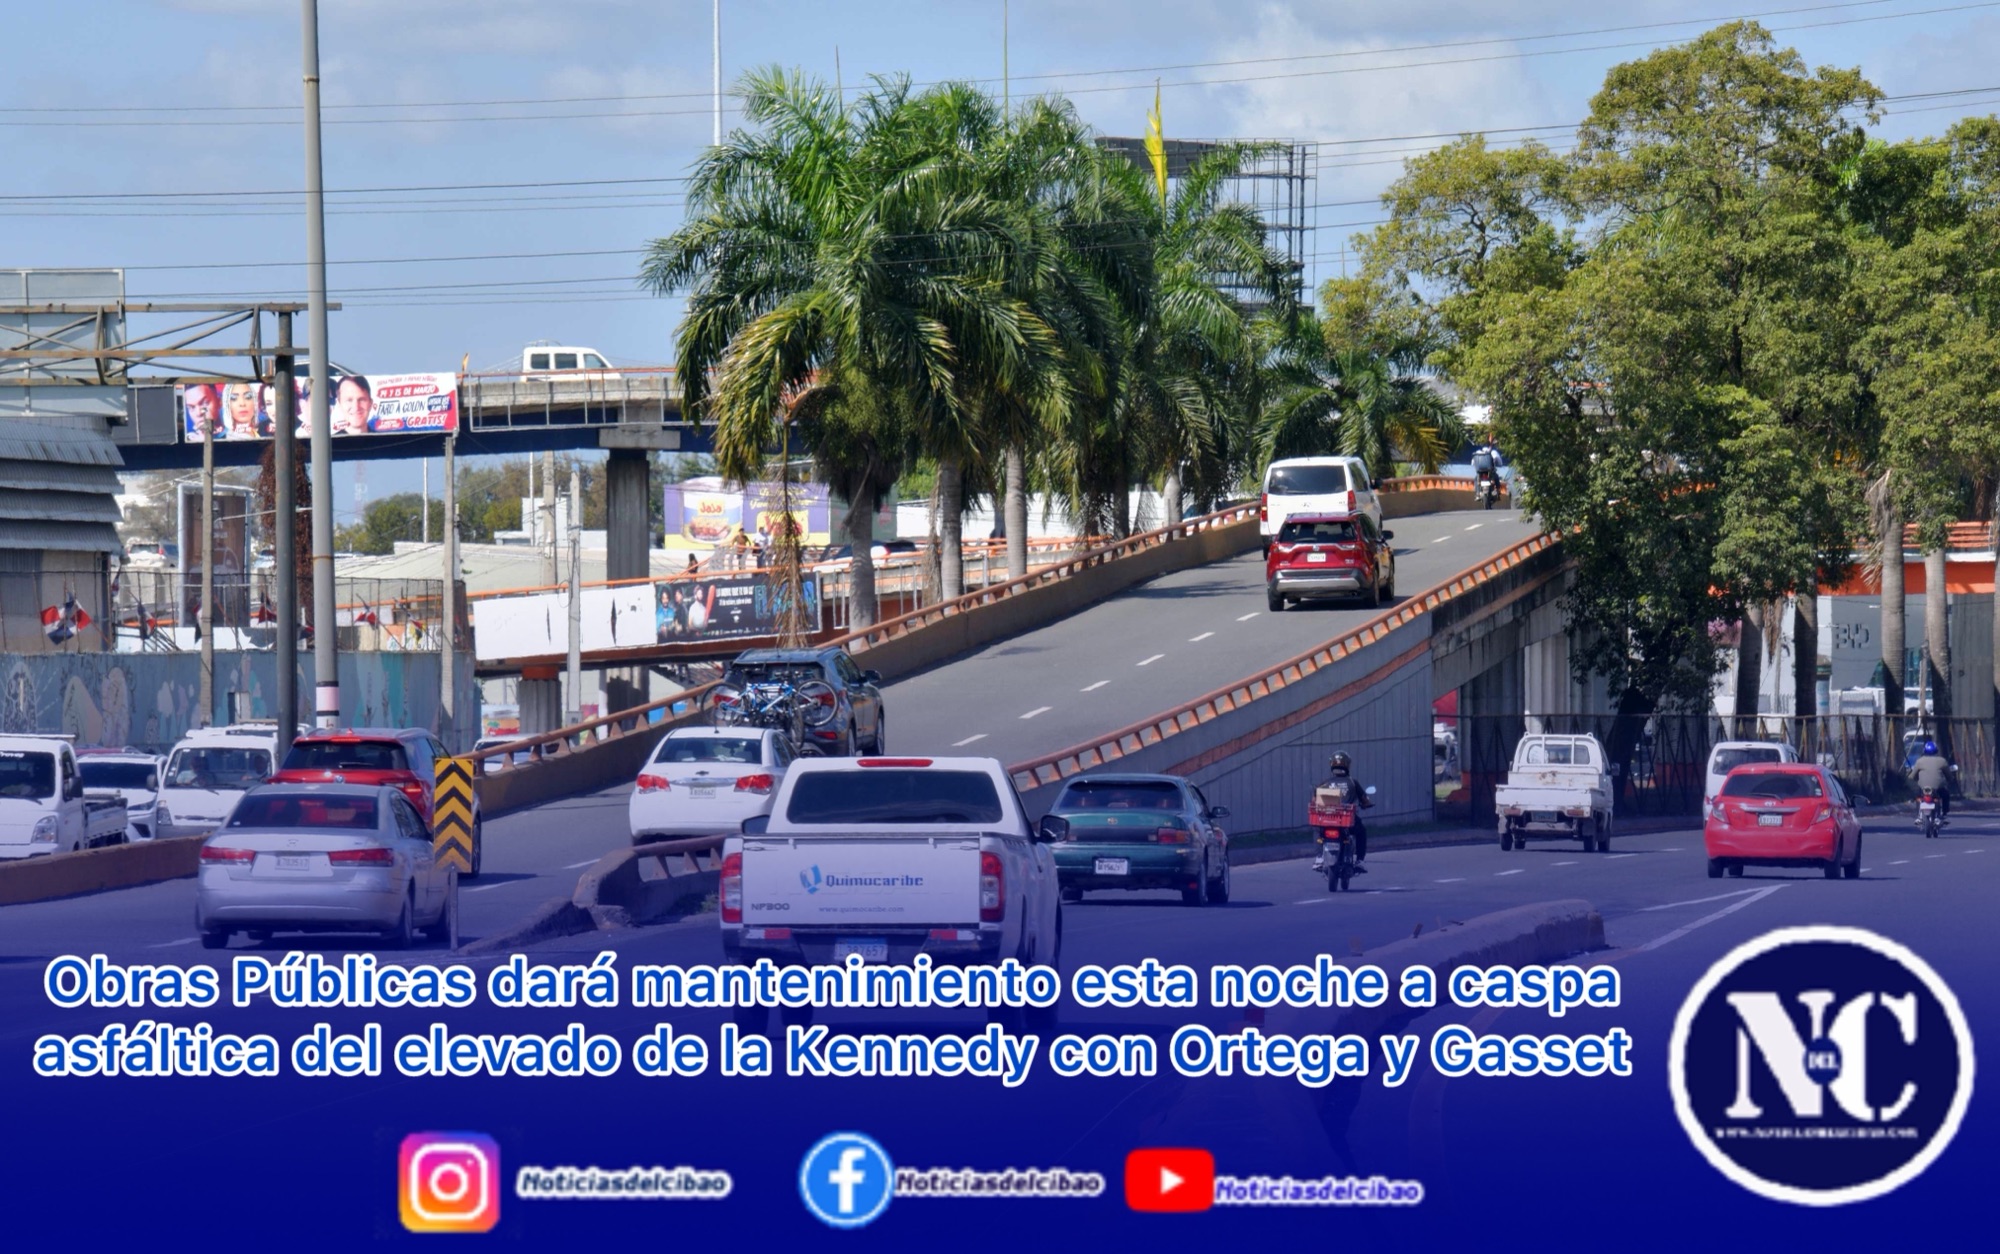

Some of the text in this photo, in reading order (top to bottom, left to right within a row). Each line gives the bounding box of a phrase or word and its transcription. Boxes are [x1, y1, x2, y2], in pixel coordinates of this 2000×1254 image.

[1836, 623, 1869, 648] BYD
[826, 874, 923, 887] Quimocaribe
[751, 903, 790, 911] NP300
